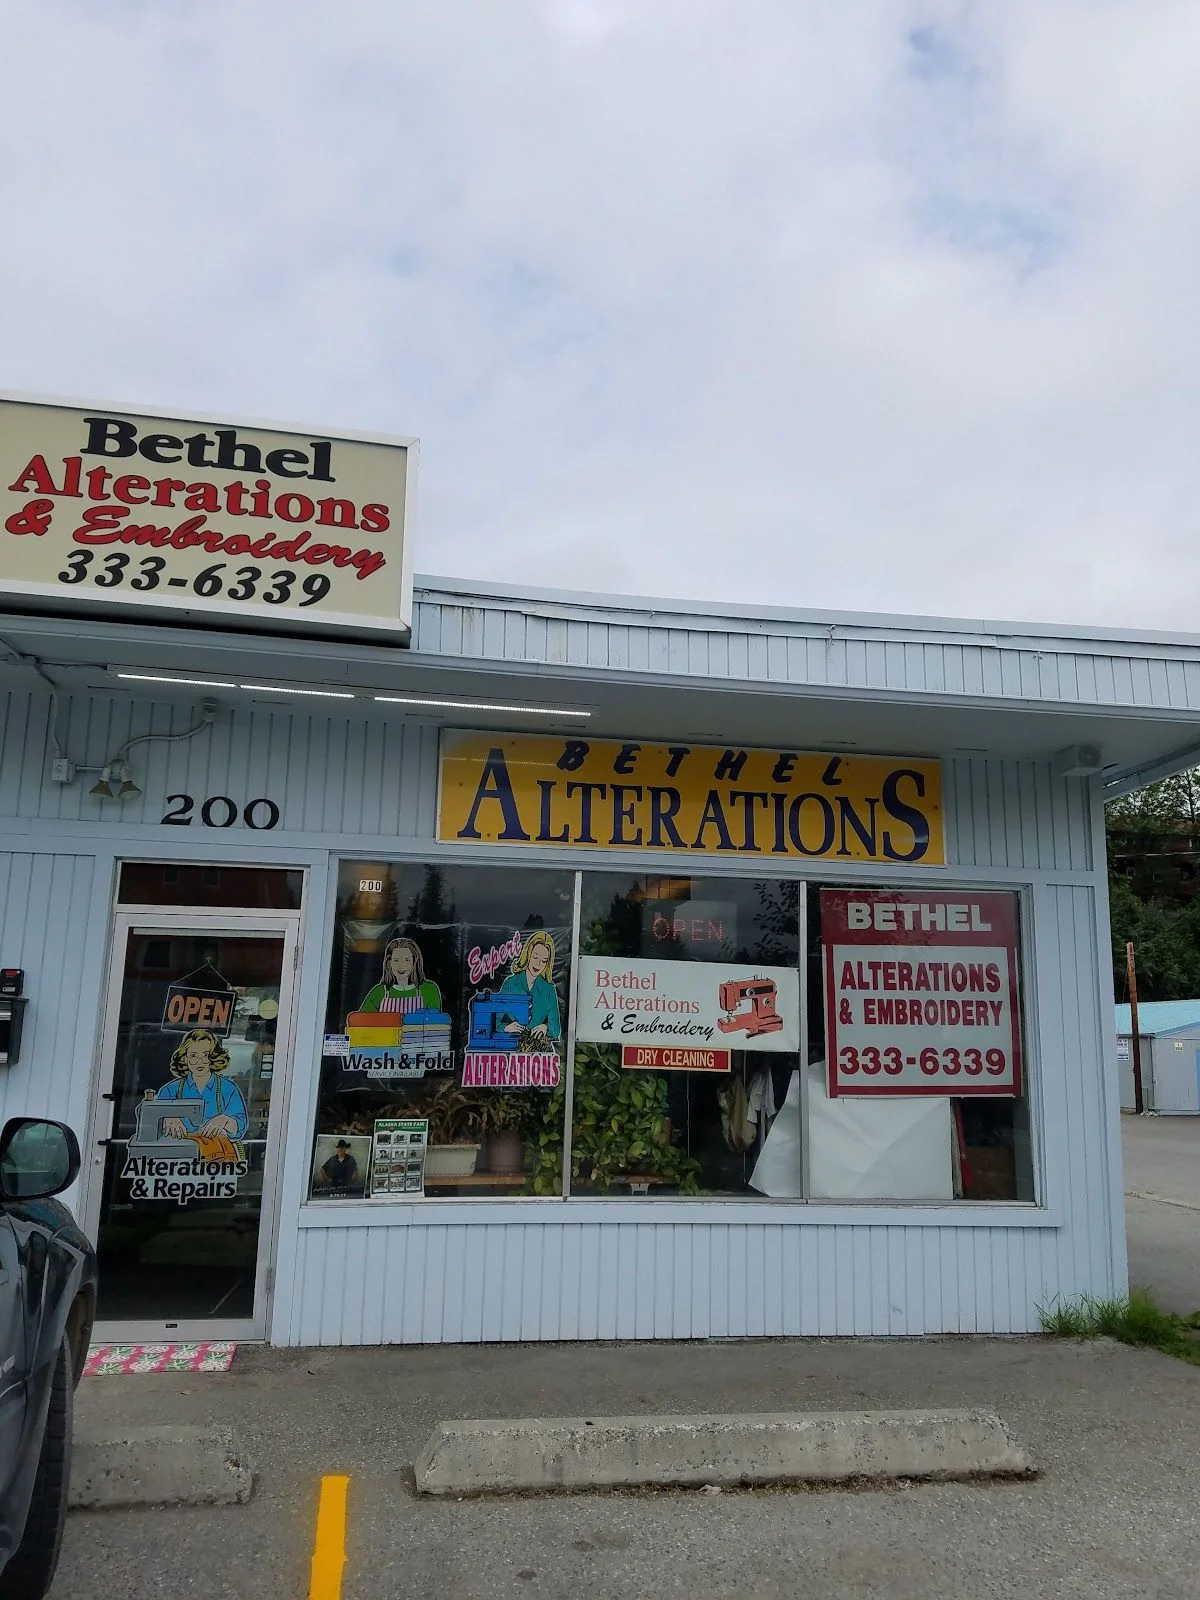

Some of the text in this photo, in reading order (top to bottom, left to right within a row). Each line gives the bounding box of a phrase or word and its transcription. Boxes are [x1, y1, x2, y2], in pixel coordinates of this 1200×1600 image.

[81, 417, 336, 482] Bethel
[8, 454, 390, 532] Alterations
[5, 498, 386, 580] & Embroidery
[58, 549, 331, 607] 333-6339
[556, 740, 842, 786] BETHEL
[161, 794, 279, 830] 200
[457, 748, 930, 861] ALTERATIONS
[361, 881, 381, 891] 200
[652, 918, 724, 942] OPEN
[847, 902, 992, 932] BETHEL
[468, 932, 522, 983] Expert
[595, 969, 657, 990] Bethel
[840, 961, 1001, 993] ALTERATIONS
[168, 994, 230, 1026] OPEN
[594, 992, 700, 1014] Alterations
[839, 998, 1003, 1026] & EMBROIDERY
[601, 1013, 715, 1041] & Embroidery
[342, 1052, 454, 1070] Wash & Fold
[464, 1054, 559, 1085] ALTERATIONS
[637, 1049, 715, 1067] DRY CLEANING
[839, 1046, 1006, 1076] 333-6339
[123, 1156, 247, 1177] Alterations
[131, 1177, 236, 1203] & Repairs
